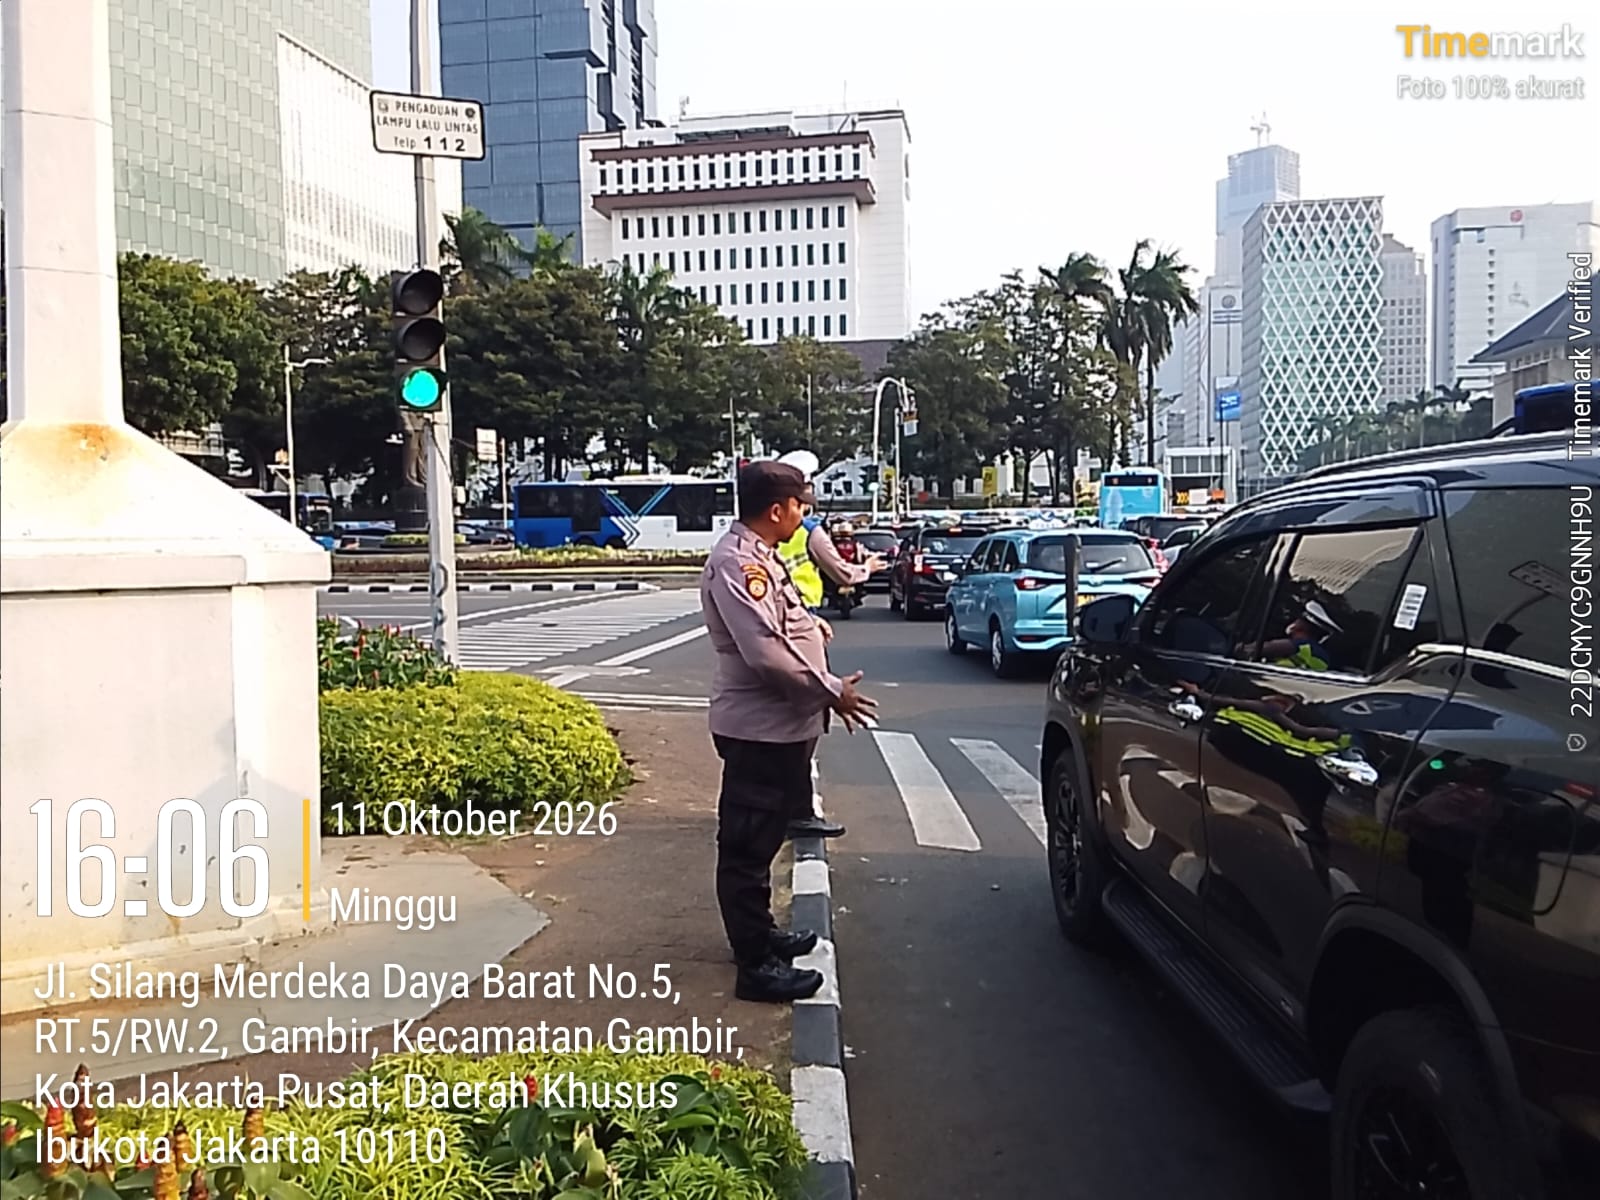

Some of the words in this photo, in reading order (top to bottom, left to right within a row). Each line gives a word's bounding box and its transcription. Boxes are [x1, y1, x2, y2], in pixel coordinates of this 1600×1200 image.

[395, 101, 458, 116] PENGADUAN
[377, 115, 412, 128] LAMPU
[416, 120, 441, 131] LALU
[444, 122, 478, 134] LINTAS
